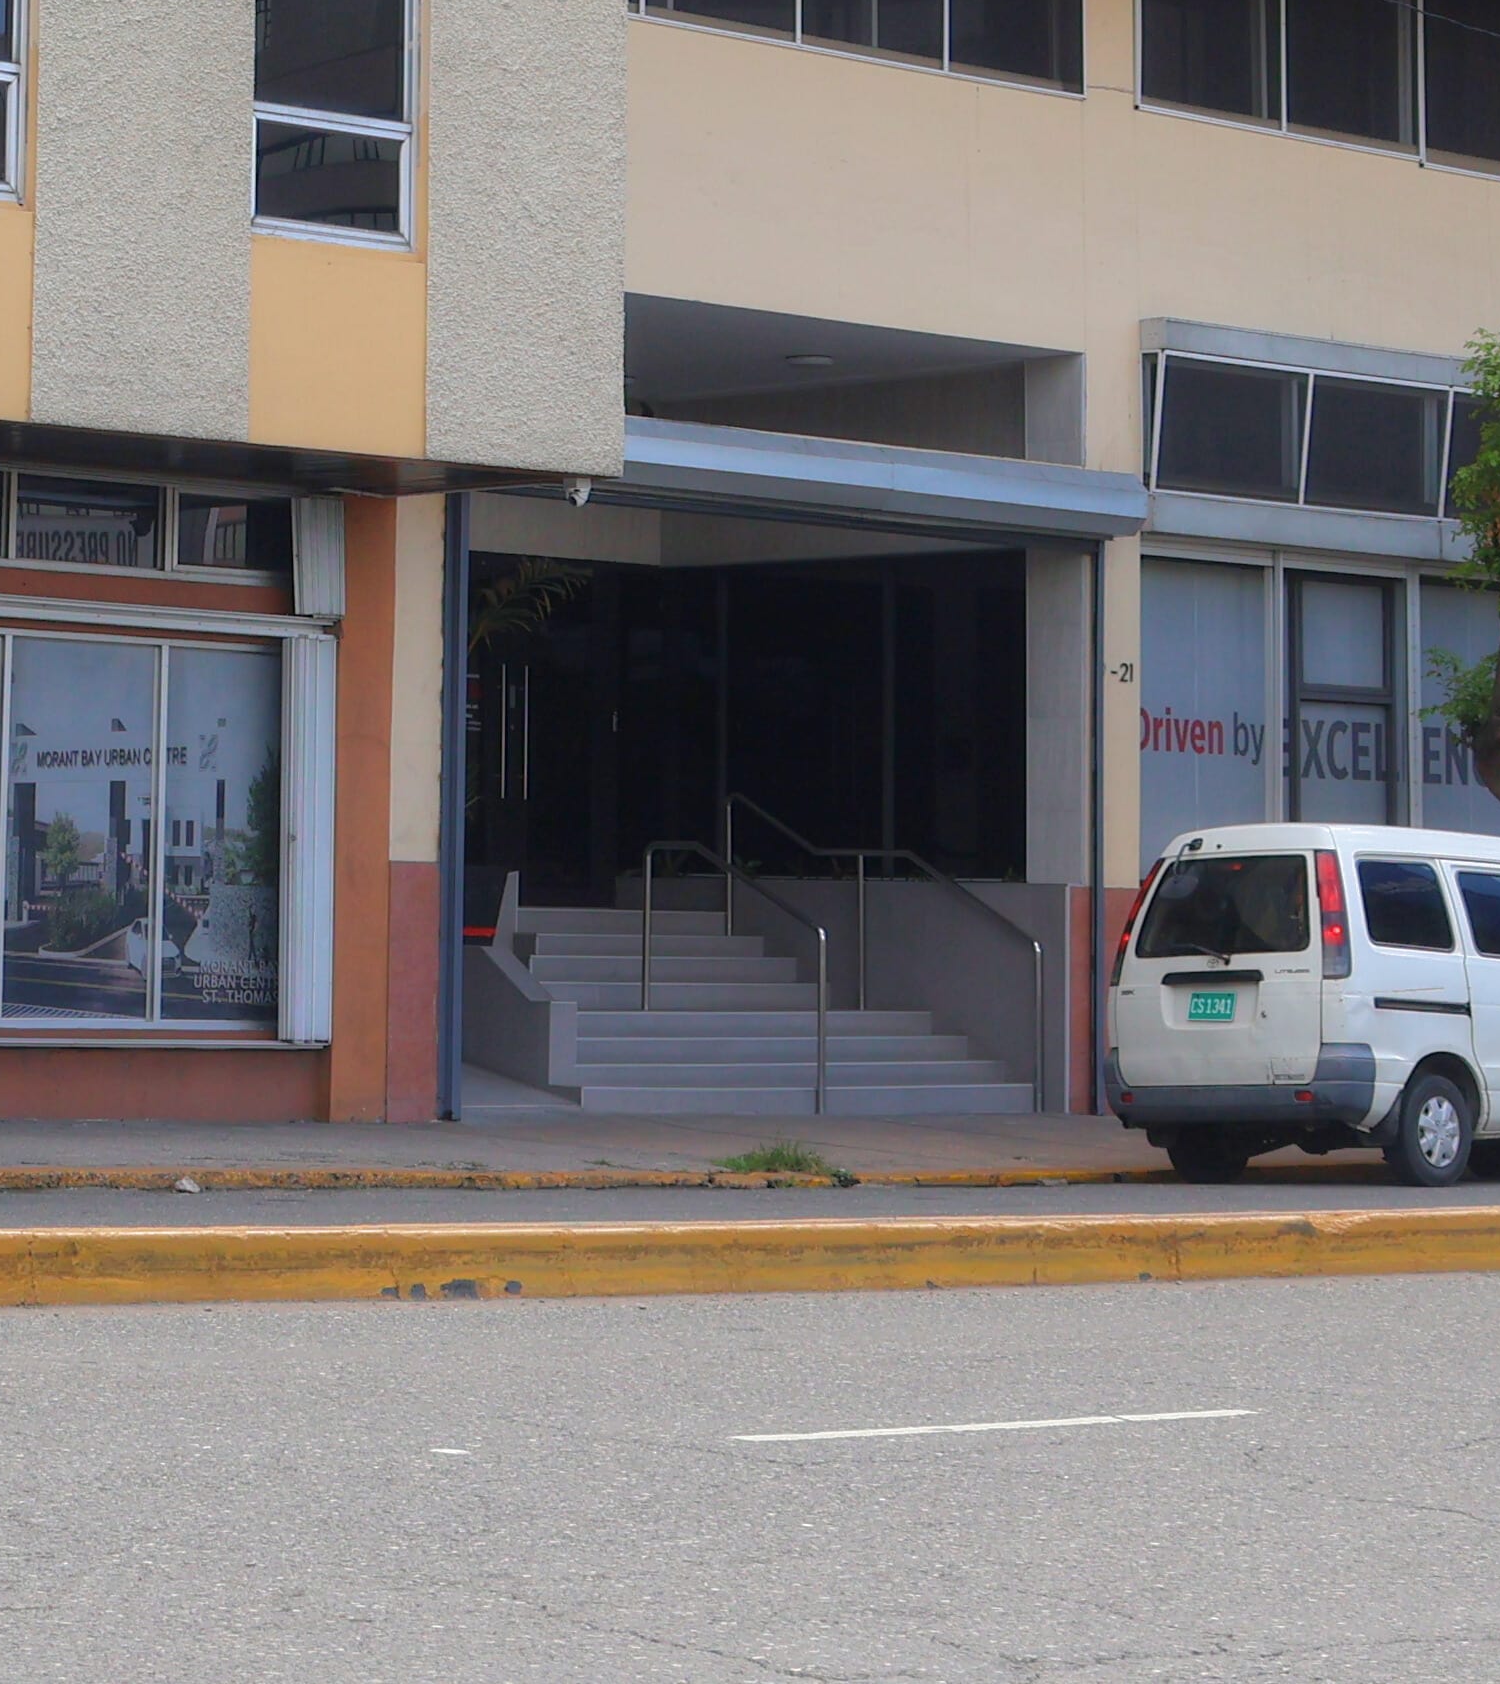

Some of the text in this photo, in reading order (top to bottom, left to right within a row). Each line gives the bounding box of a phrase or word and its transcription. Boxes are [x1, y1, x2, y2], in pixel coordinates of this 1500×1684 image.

[1233, 711, 1265, 766] by
[36, 746, 187, 769] MORANT BAY URBAN CTRE
[200, 959, 255, 973] MORANT
[193, 974, 236, 989] URBAN
[202, 989, 221, 1003] ST.
